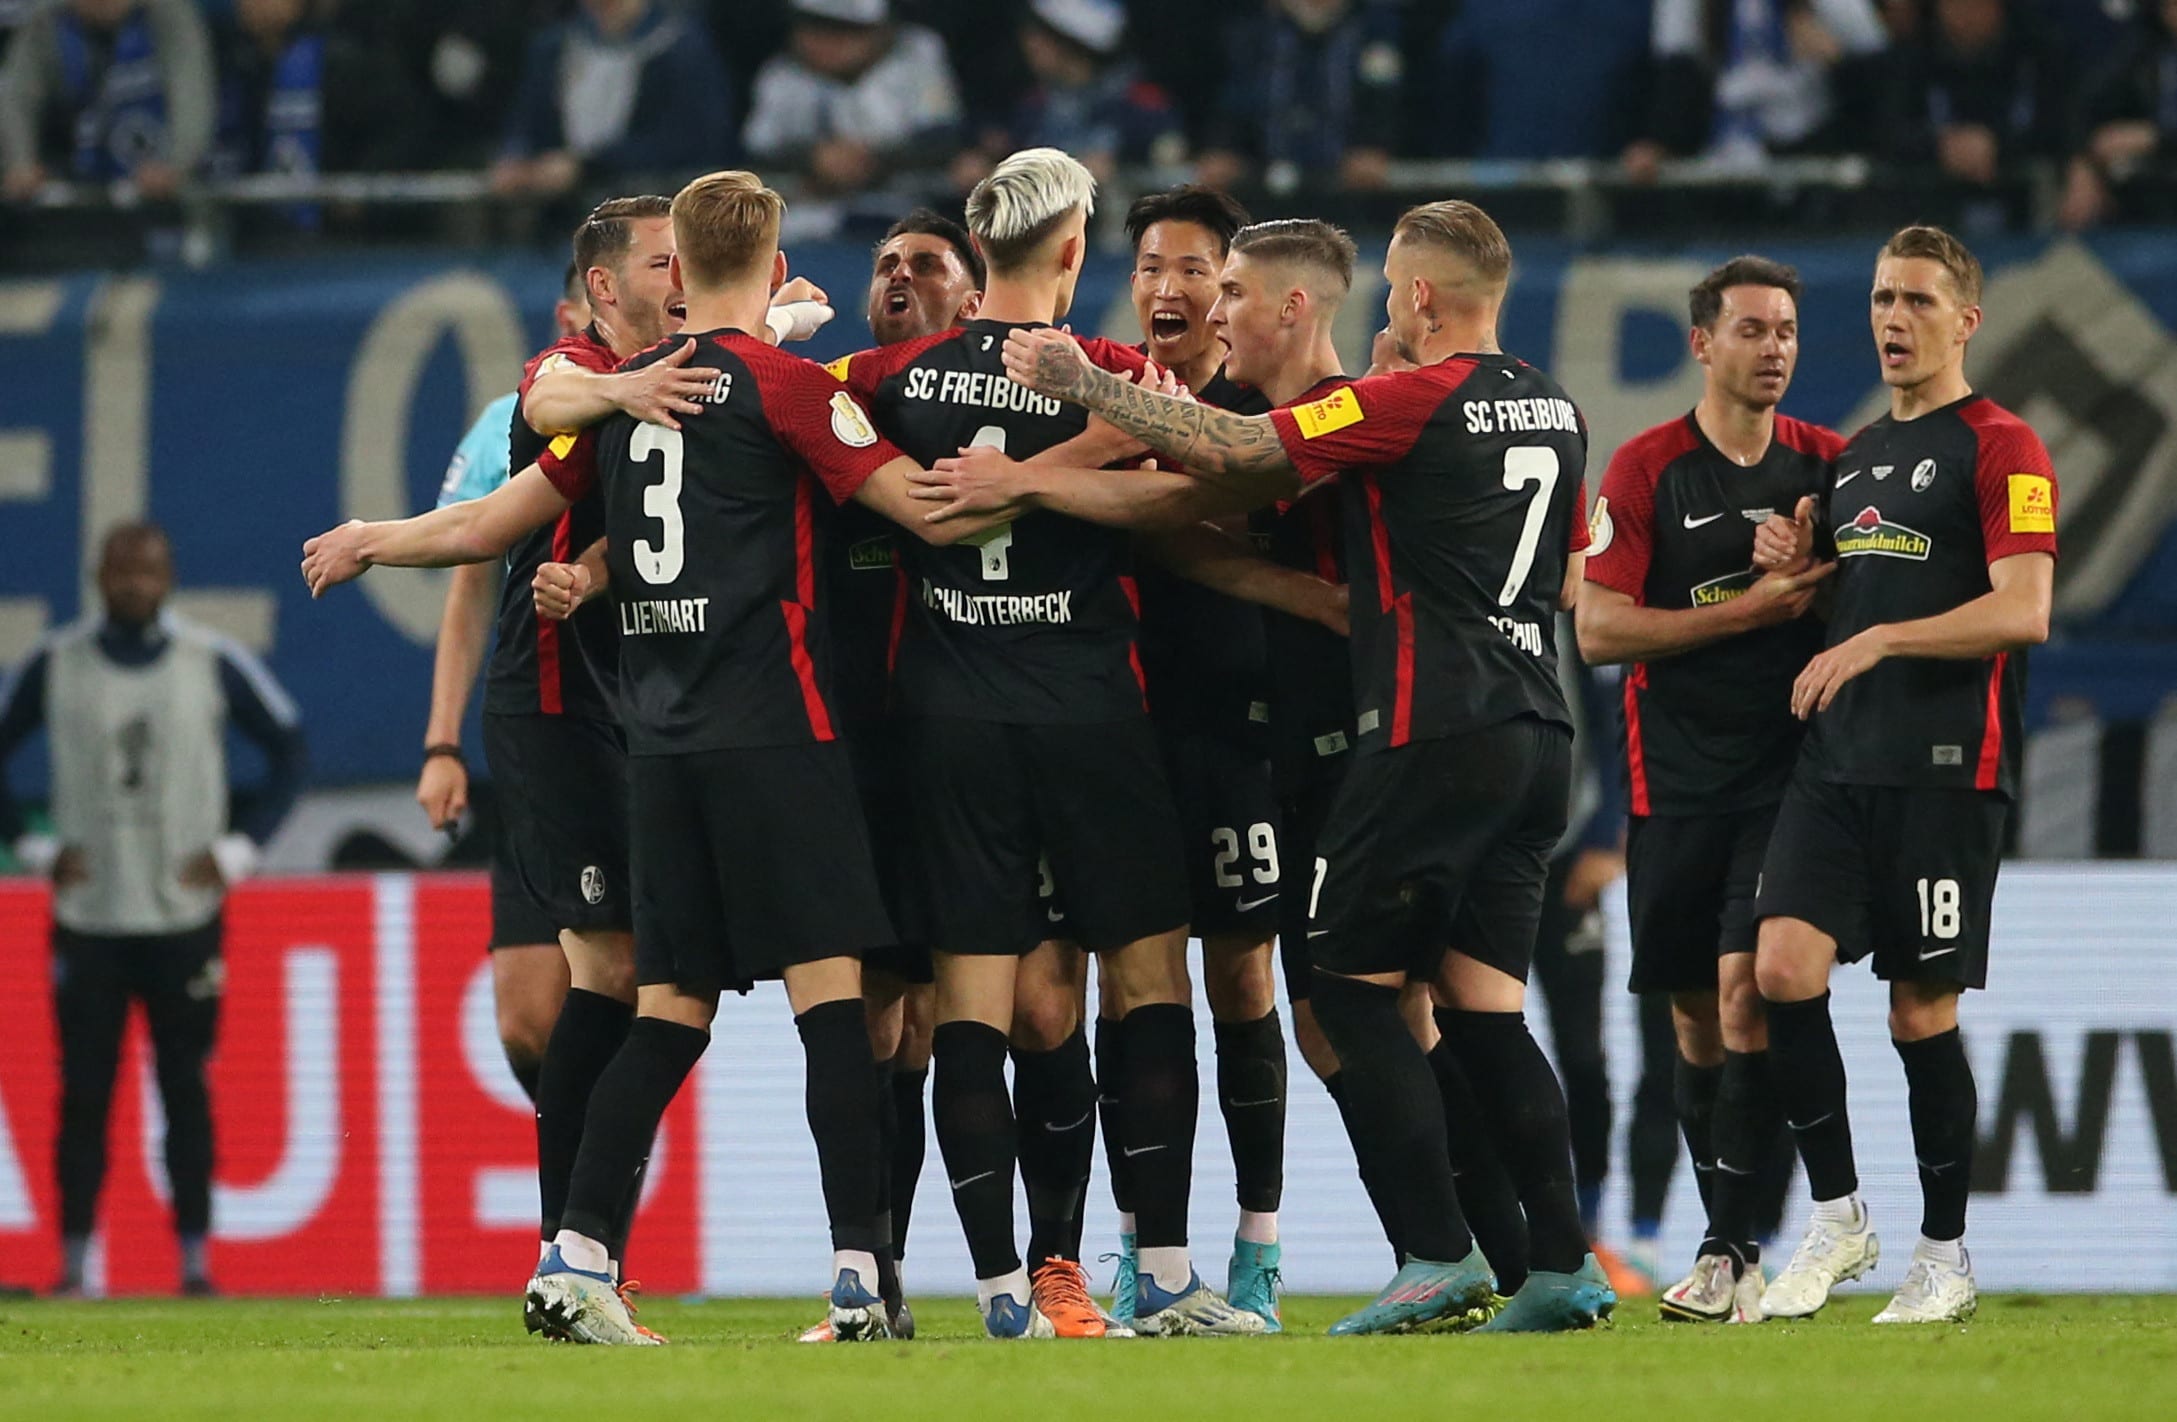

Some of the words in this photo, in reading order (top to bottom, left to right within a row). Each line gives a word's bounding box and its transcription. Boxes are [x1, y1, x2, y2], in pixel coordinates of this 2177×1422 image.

[904, 367, 938, 400] SC
[939, 371, 1062, 417] FREIBURG
[1463, 400, 1493, 434] SC
[629, 420, 685, 585] 3
[1502, 446, 1560, 607] 7
[2021, 505, 2050, 515] LOTTO
[620, 598, 709, 636] LIENHART
[1211, 822, 1280, 888] 29
[1917, 878, 1960, 939] 18
